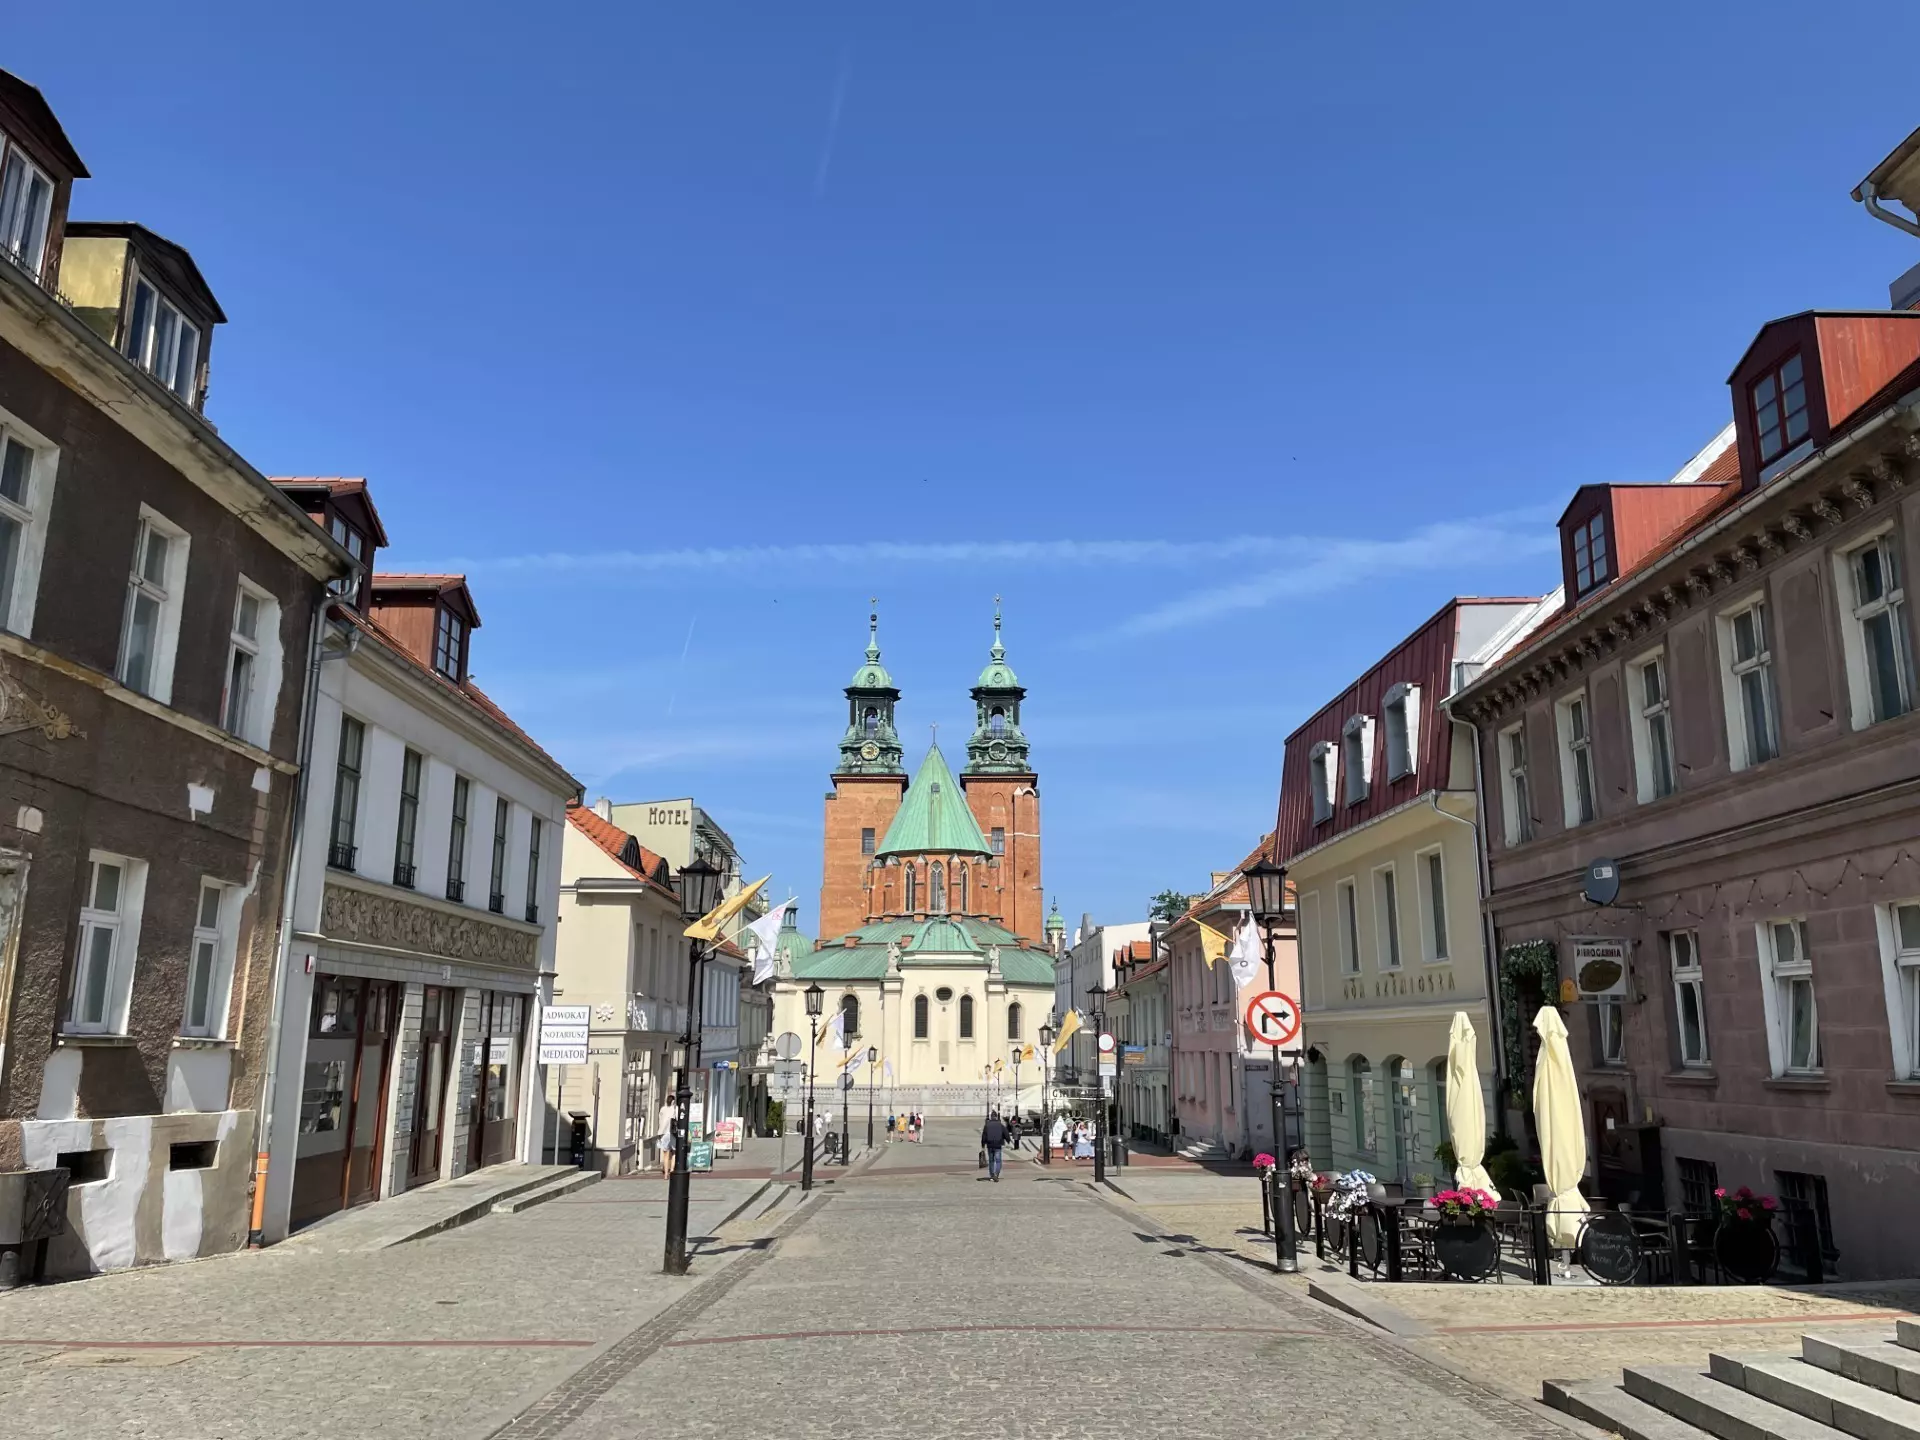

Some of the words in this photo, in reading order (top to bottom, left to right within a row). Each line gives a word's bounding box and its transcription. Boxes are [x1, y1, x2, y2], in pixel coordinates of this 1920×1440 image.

[649, 807, 689, 825] HOTEL
[545, 1011, 587, 1020] ADWOKAT
[544, 1031, 586, 1039] NOTARIUSZ
[542, 1049, 585, 1059] MEDIATOR
